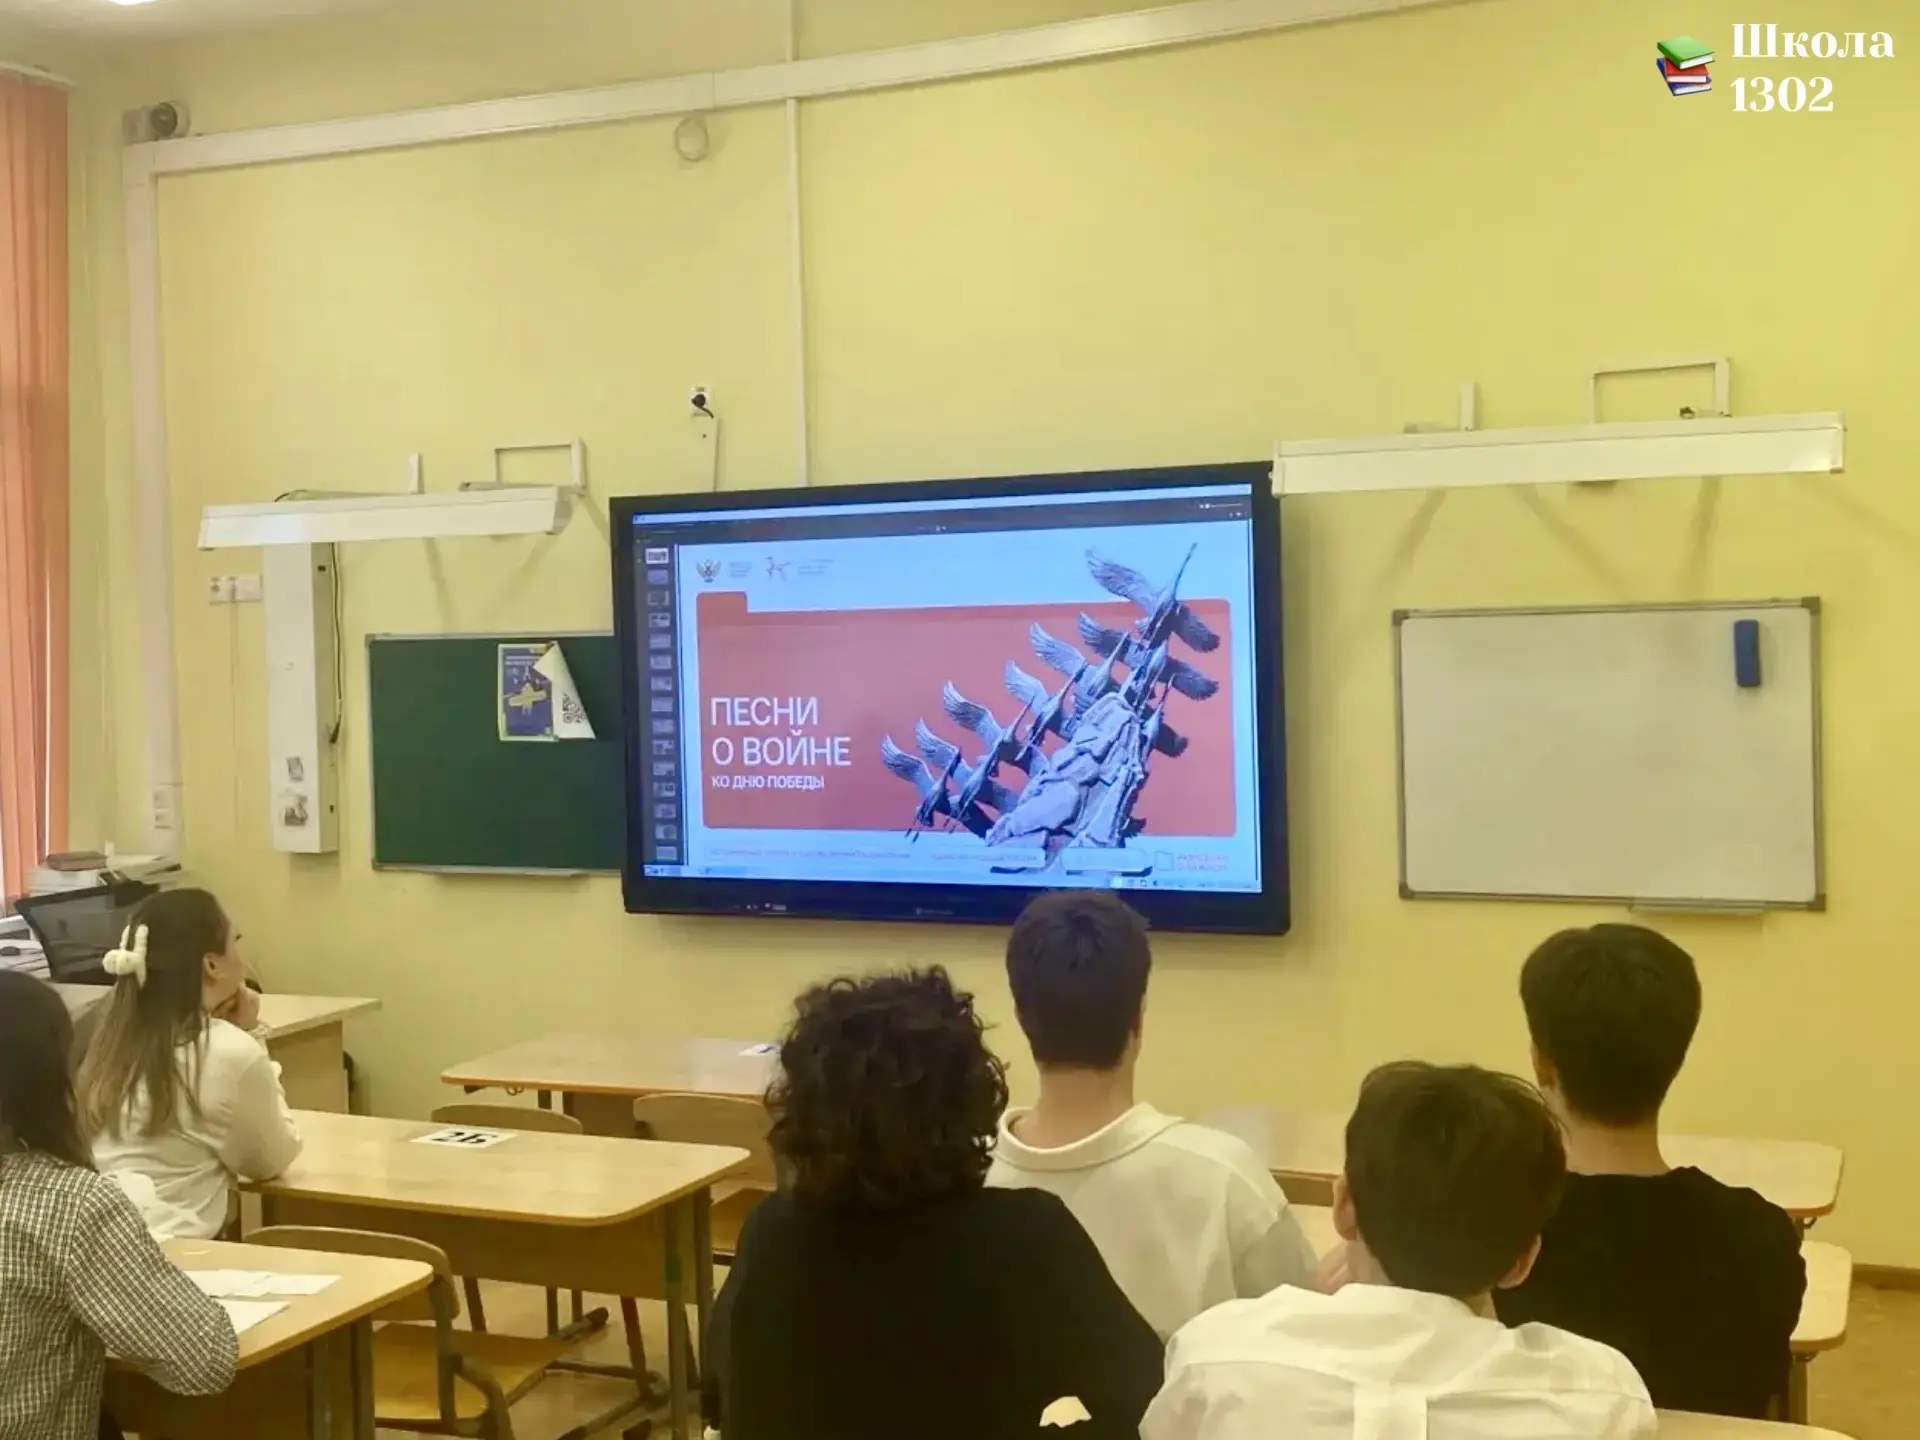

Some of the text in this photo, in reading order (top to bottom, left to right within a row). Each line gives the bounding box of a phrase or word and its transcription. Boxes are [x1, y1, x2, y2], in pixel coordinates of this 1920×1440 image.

[710, 696, 819, 726] ПЕСНИ
[712, 728, 851, 766] О ВОЙНЕ
[711, 775, 825, 790] КО ДНЮ ПОБЕДЫ
